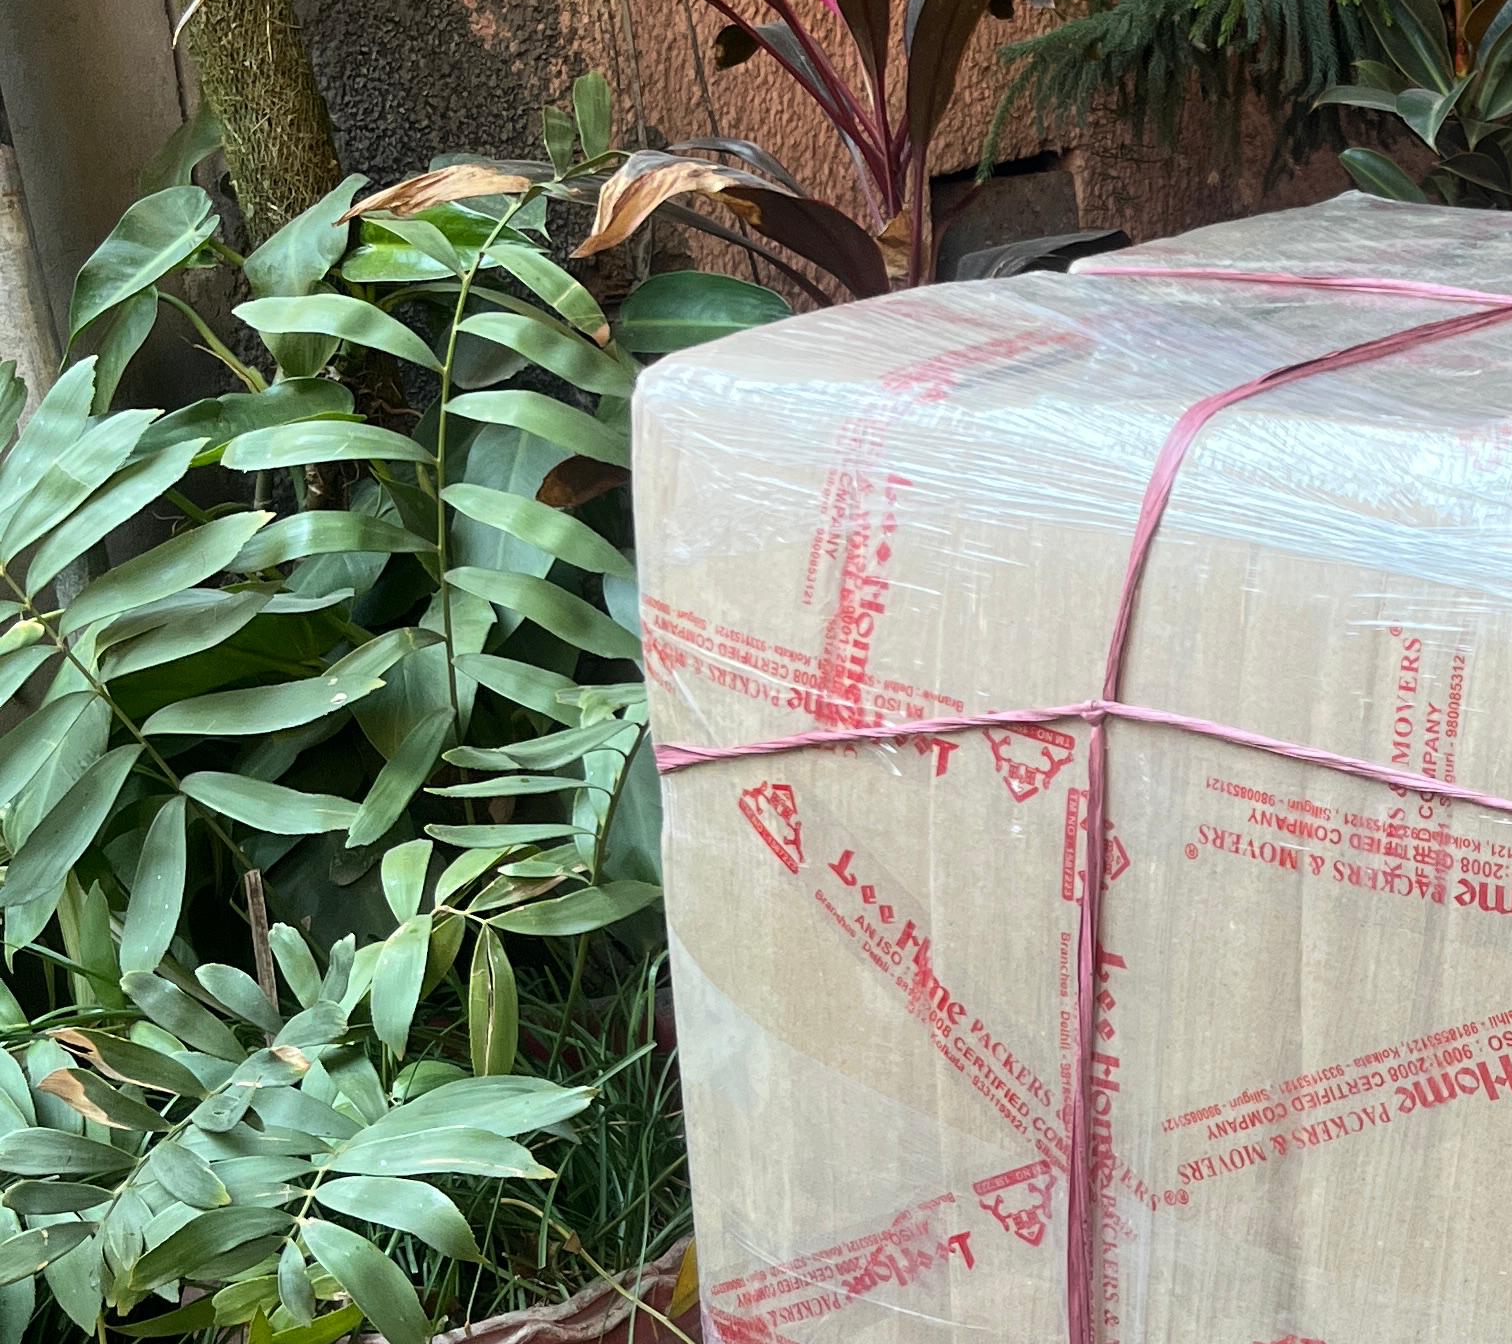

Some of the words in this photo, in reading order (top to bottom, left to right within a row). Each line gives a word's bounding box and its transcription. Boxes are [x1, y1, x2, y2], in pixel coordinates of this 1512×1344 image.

[873, 693, 901, 712] ISO
[1206, 778, 1276, 806] 9800853121
[1066, 818, 1076, 835] NO
[1248, 809, 1343, 845] COMPANY
[1308, 853, 1325, 876] &
[853, 915, 877, 940] AN
[875, 936, 902, 966] ISO
[952, 1036, 1029, 1117] CERTIFIED
[969, 1018, 1052, 1106] PACKERS
[1352, 1048, 1401, 1069] Kolkata
[1387, 1044, 1473, 1083] 9001:2008
[1289, 1071, 1386, 1113] CERTIFIED
[1206, 1102, 1288, 1140] COMPANY
[1290, 1103, 1392, 1150] PACKERS
[1271, 1135, 1288, 1156] &
[776, 1293, 842, 1323] PACKERS
[1103, 1309, 1119, 1327] &
